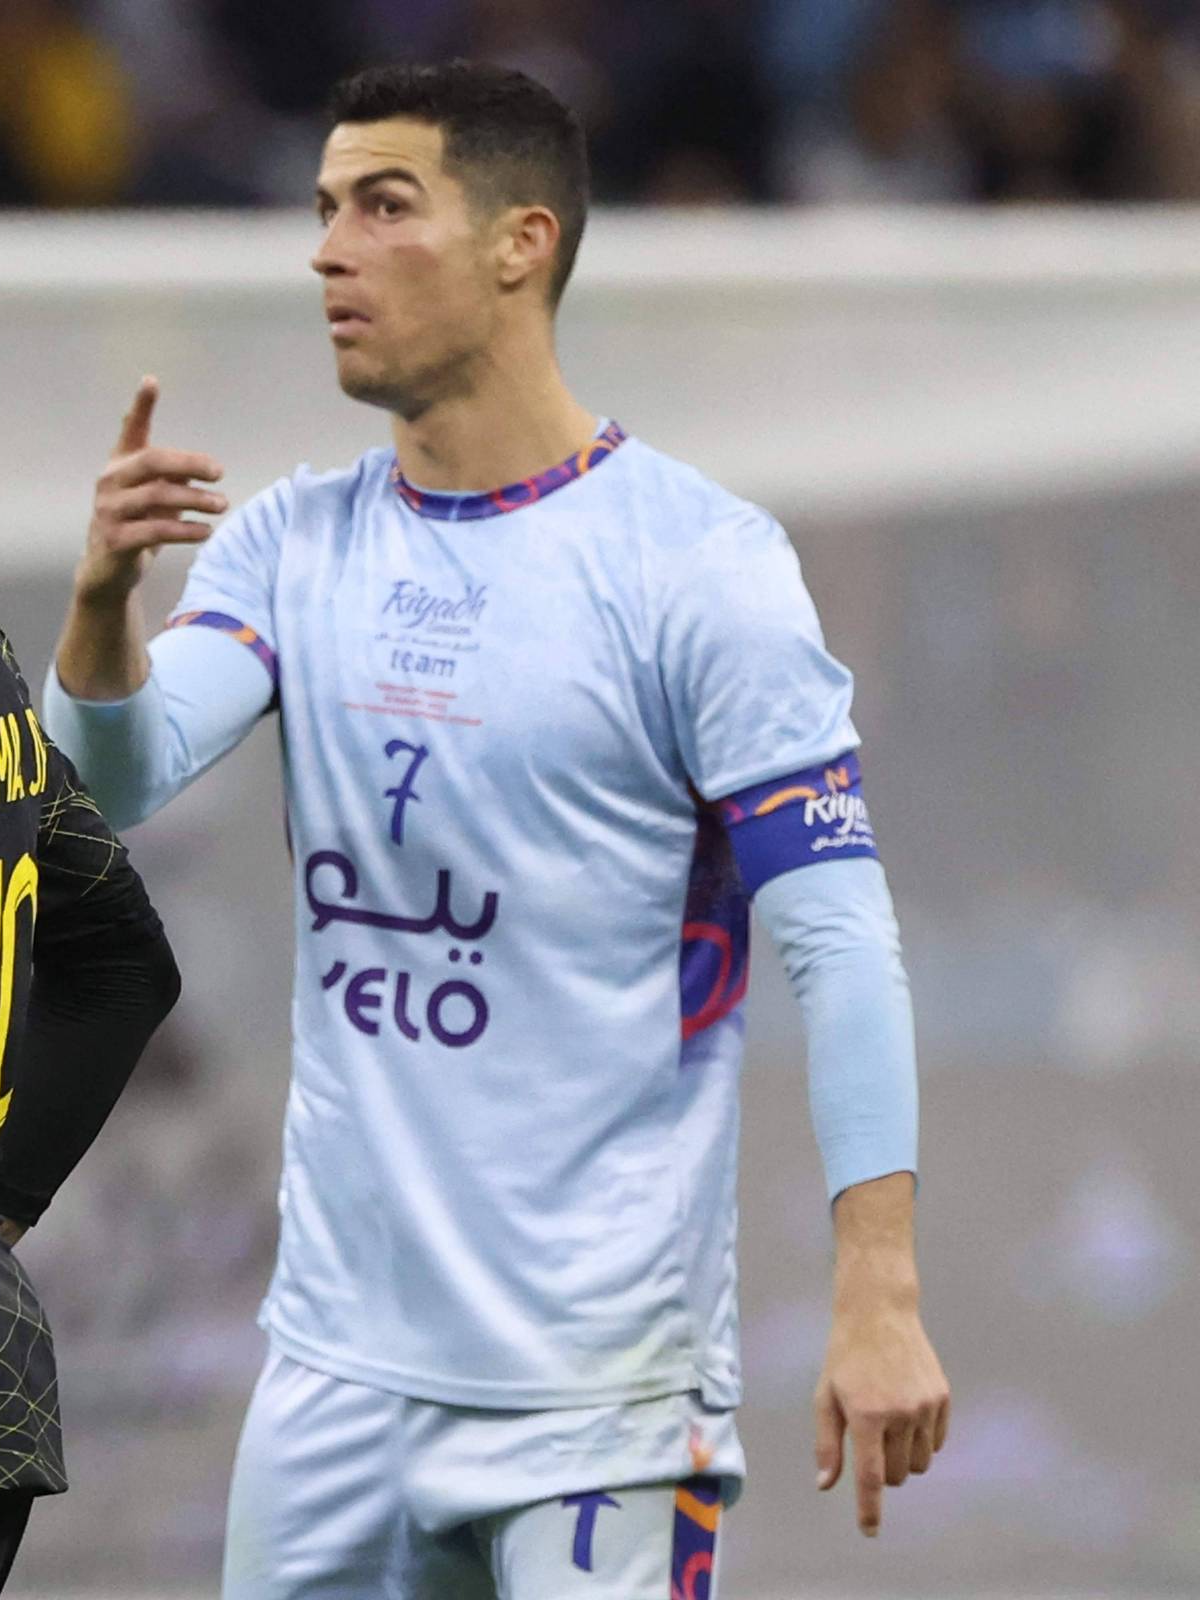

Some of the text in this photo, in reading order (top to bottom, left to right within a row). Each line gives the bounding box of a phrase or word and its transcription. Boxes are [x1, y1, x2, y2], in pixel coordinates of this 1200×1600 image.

[382, 579, 489, 629] Riyadh
[390, 649, 458, 678] team
[384, 739, 429, 847] 7
